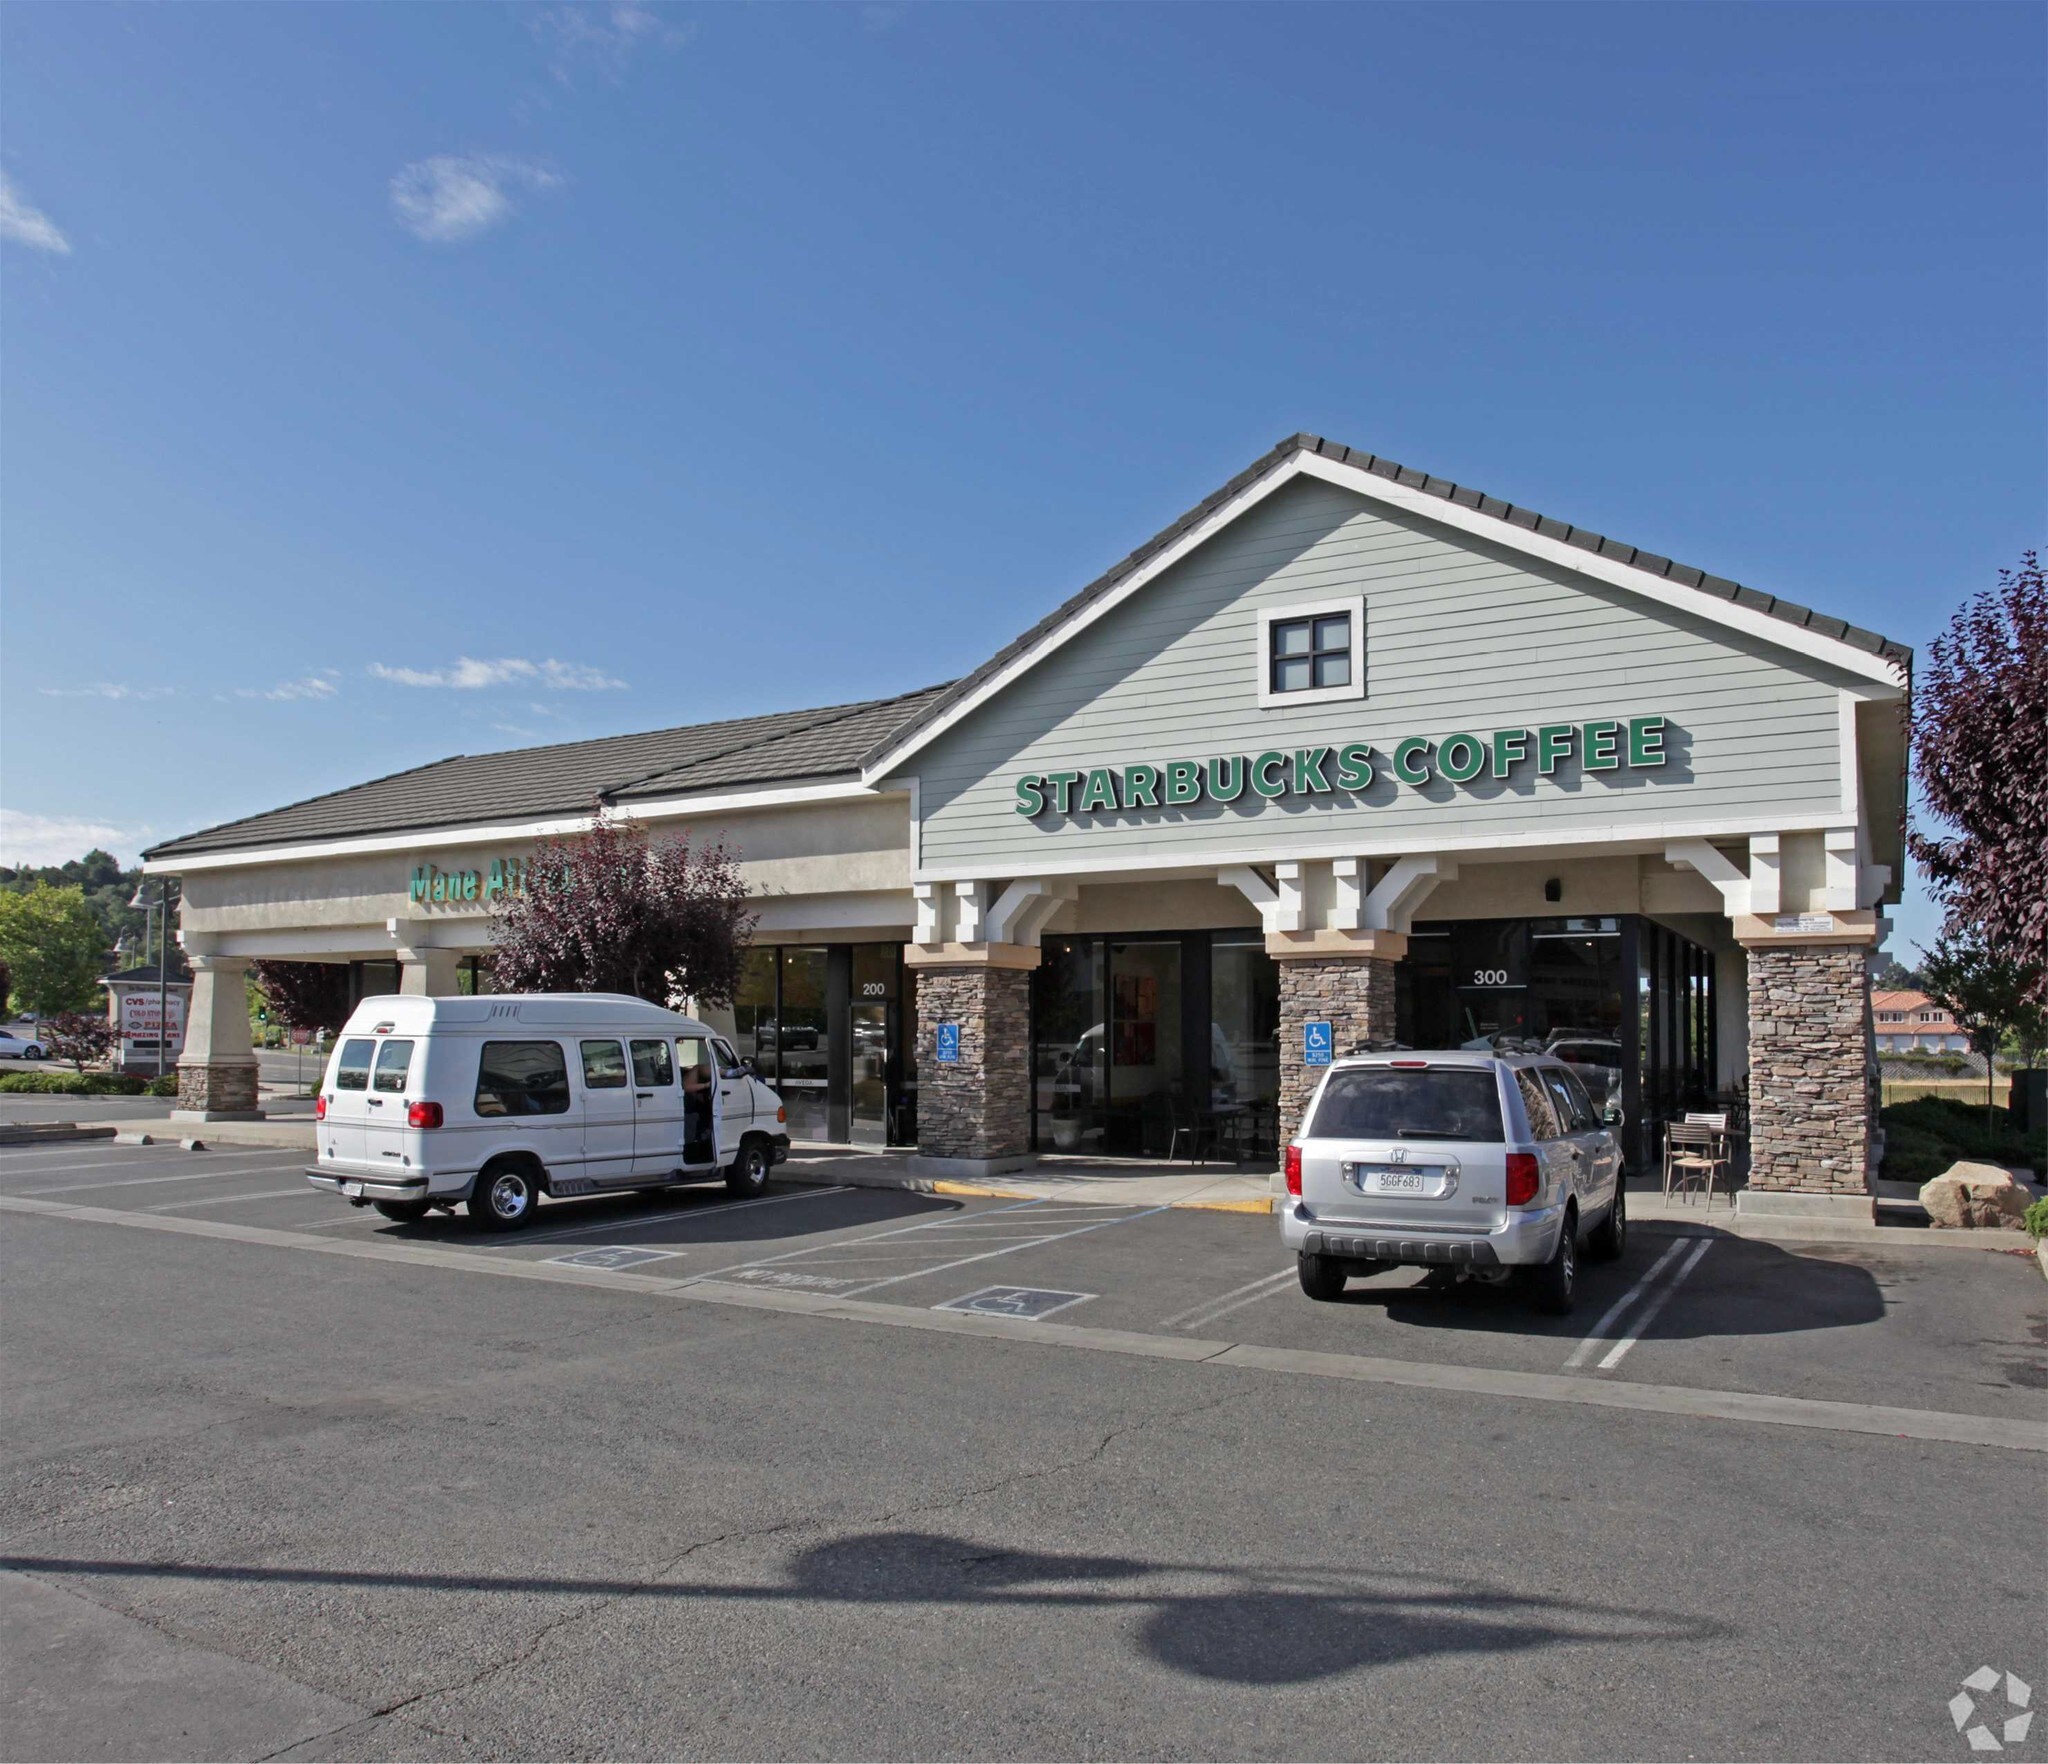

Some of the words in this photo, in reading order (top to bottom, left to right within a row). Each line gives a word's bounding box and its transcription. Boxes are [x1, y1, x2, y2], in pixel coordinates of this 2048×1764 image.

[1014, 743, 1374, 818] STARBUCKS
[1391, 715, 1667, 787] COFFEE
[410, 863, 480, 902] Mane
[1474, 970, 1507, 985] 300
[863, 983, 885, 995] 200
[126, 998, 180, 1006] CVS/phamacy
[1380, 1174, 1420, 1188] 5GGF683
